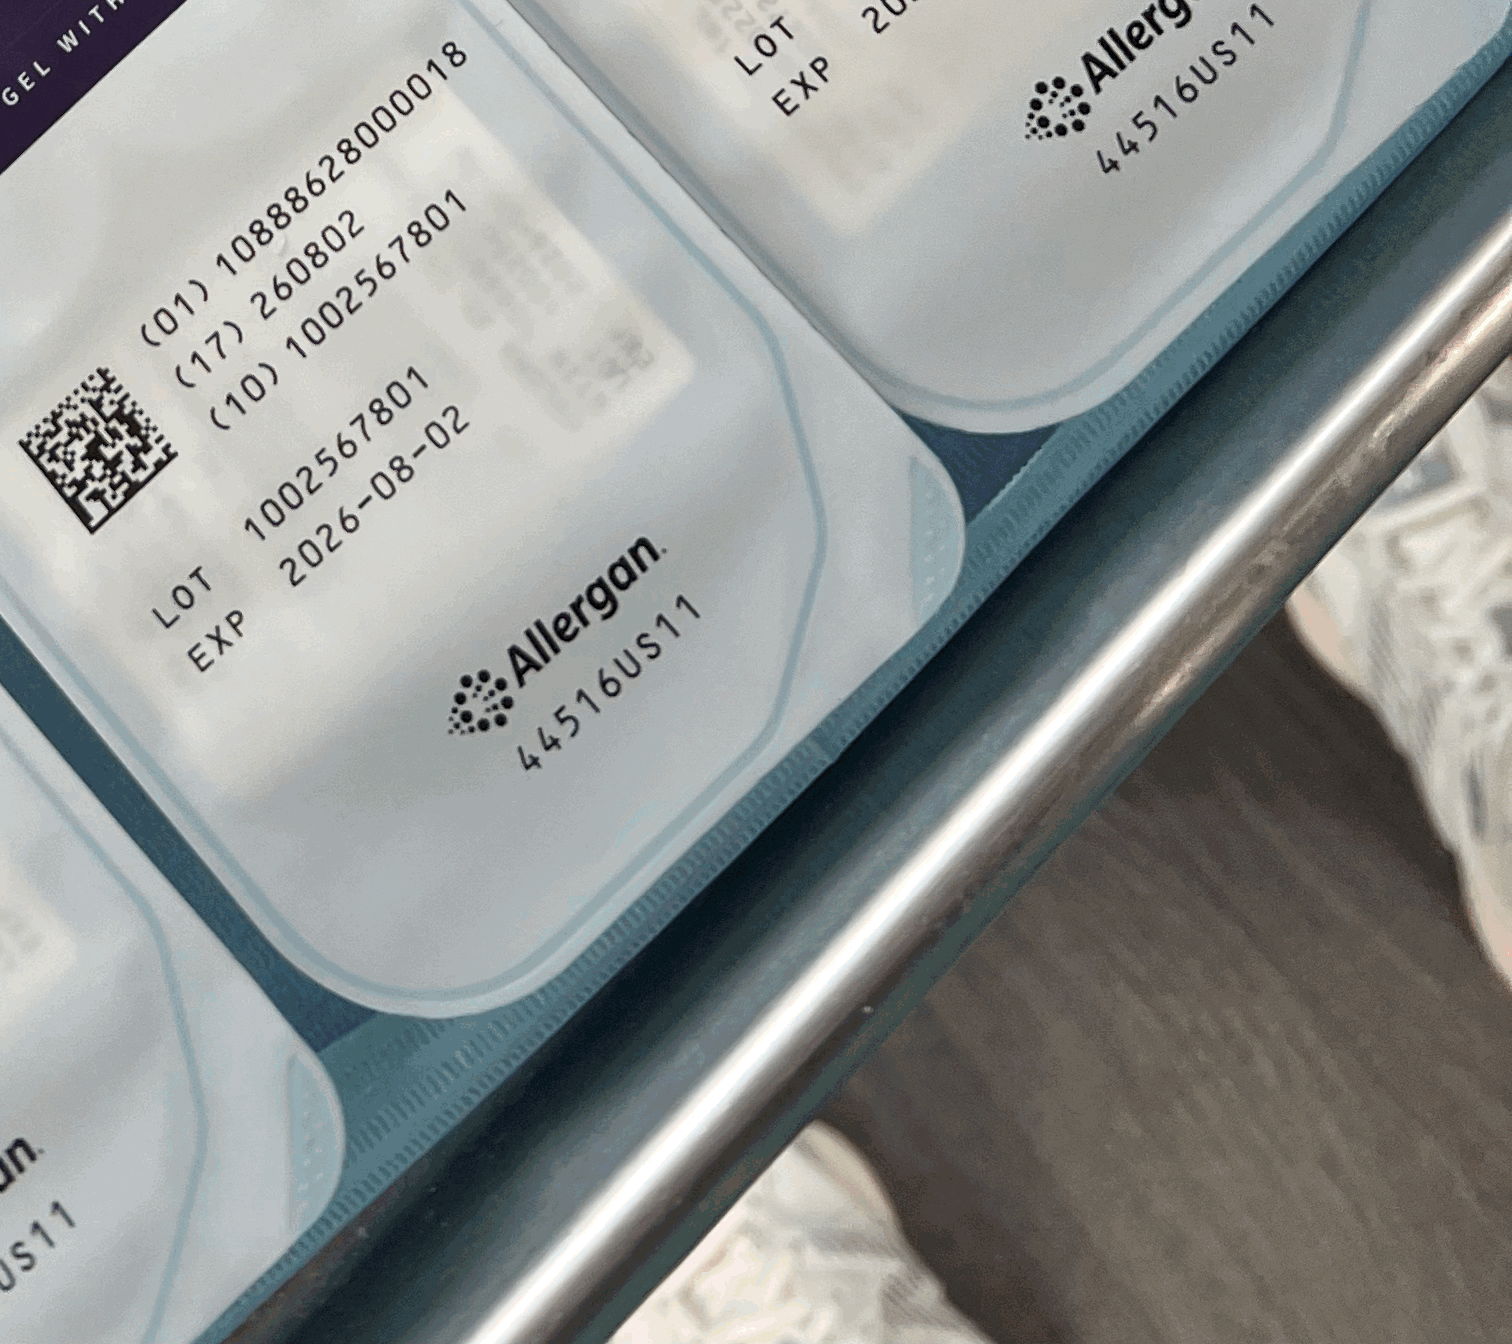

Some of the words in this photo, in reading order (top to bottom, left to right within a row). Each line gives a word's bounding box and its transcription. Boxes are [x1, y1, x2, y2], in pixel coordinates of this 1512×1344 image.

[1, 60, 51, 107] GEL
[733, 16, 797, 78] LOT
[772, 55, 832, 117] EXP
[1095, 3, 1276, 176] 44516US11
[140, 278, 211, 349] (01)
[216, 40, 469, 276] 10888628000018
[175, 320, 245, 391] (17)
[251, 209, 366, 321] 260802
[210, 361, 280, 431] (10)
[287, 188, 469, 359] 1002567801
[151, 565, 214, 629] LOT
[244, 365, 430, 541] 1002567801
[187, 609, 248, 673] EXP
[279, 404, 471, 588] 2026-08-02
[506, 534, 662, 688] Allergan
[516, 593, 704, 773] 44516US11
